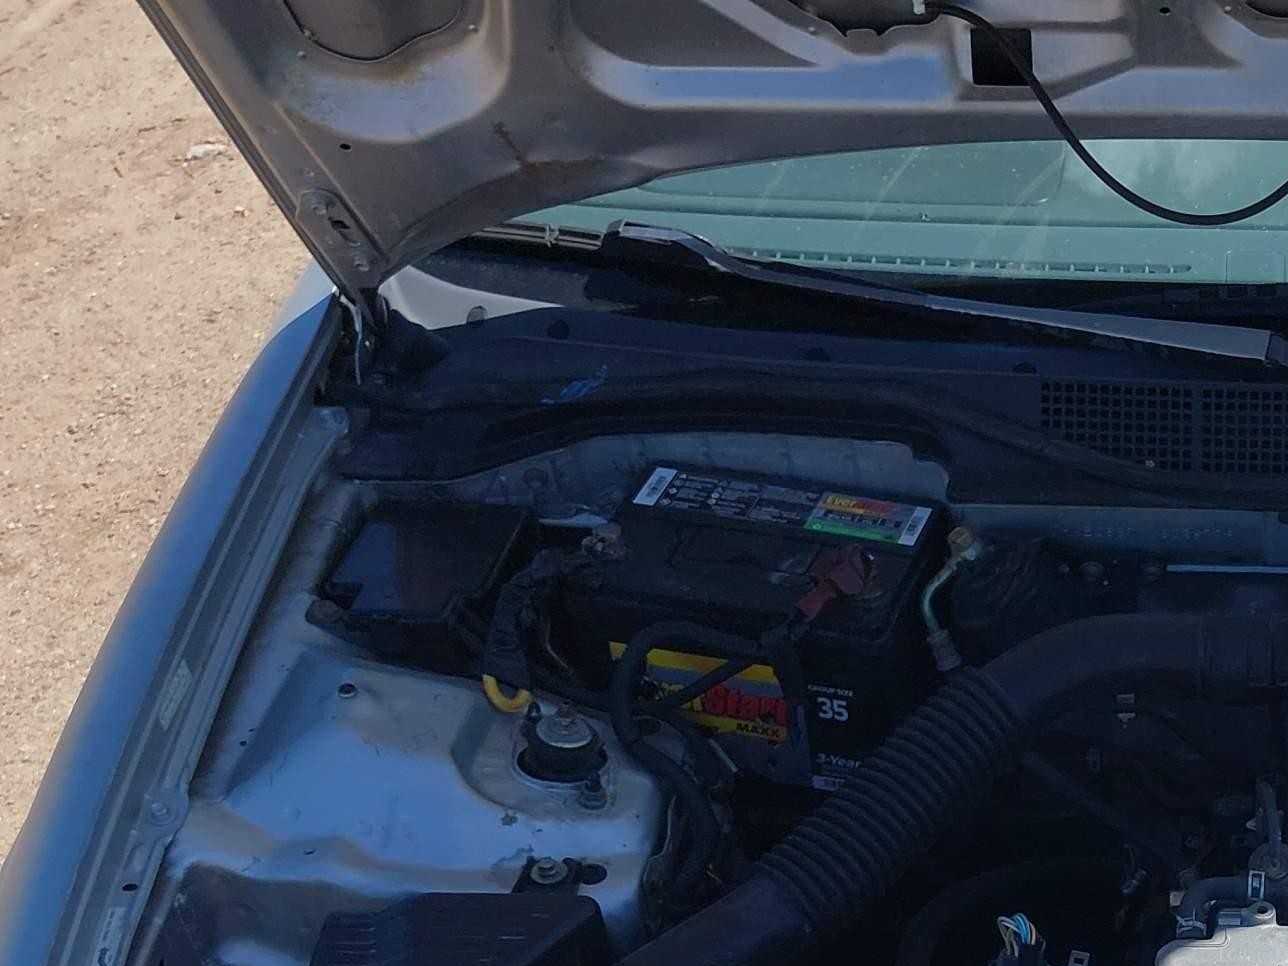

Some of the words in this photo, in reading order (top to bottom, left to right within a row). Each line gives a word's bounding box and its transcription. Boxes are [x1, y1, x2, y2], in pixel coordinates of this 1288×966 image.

[817, 697, 849, 721] 35
[736, 722, 781, 739] MAXX
[816, 753, 862, 768] 3-Year
